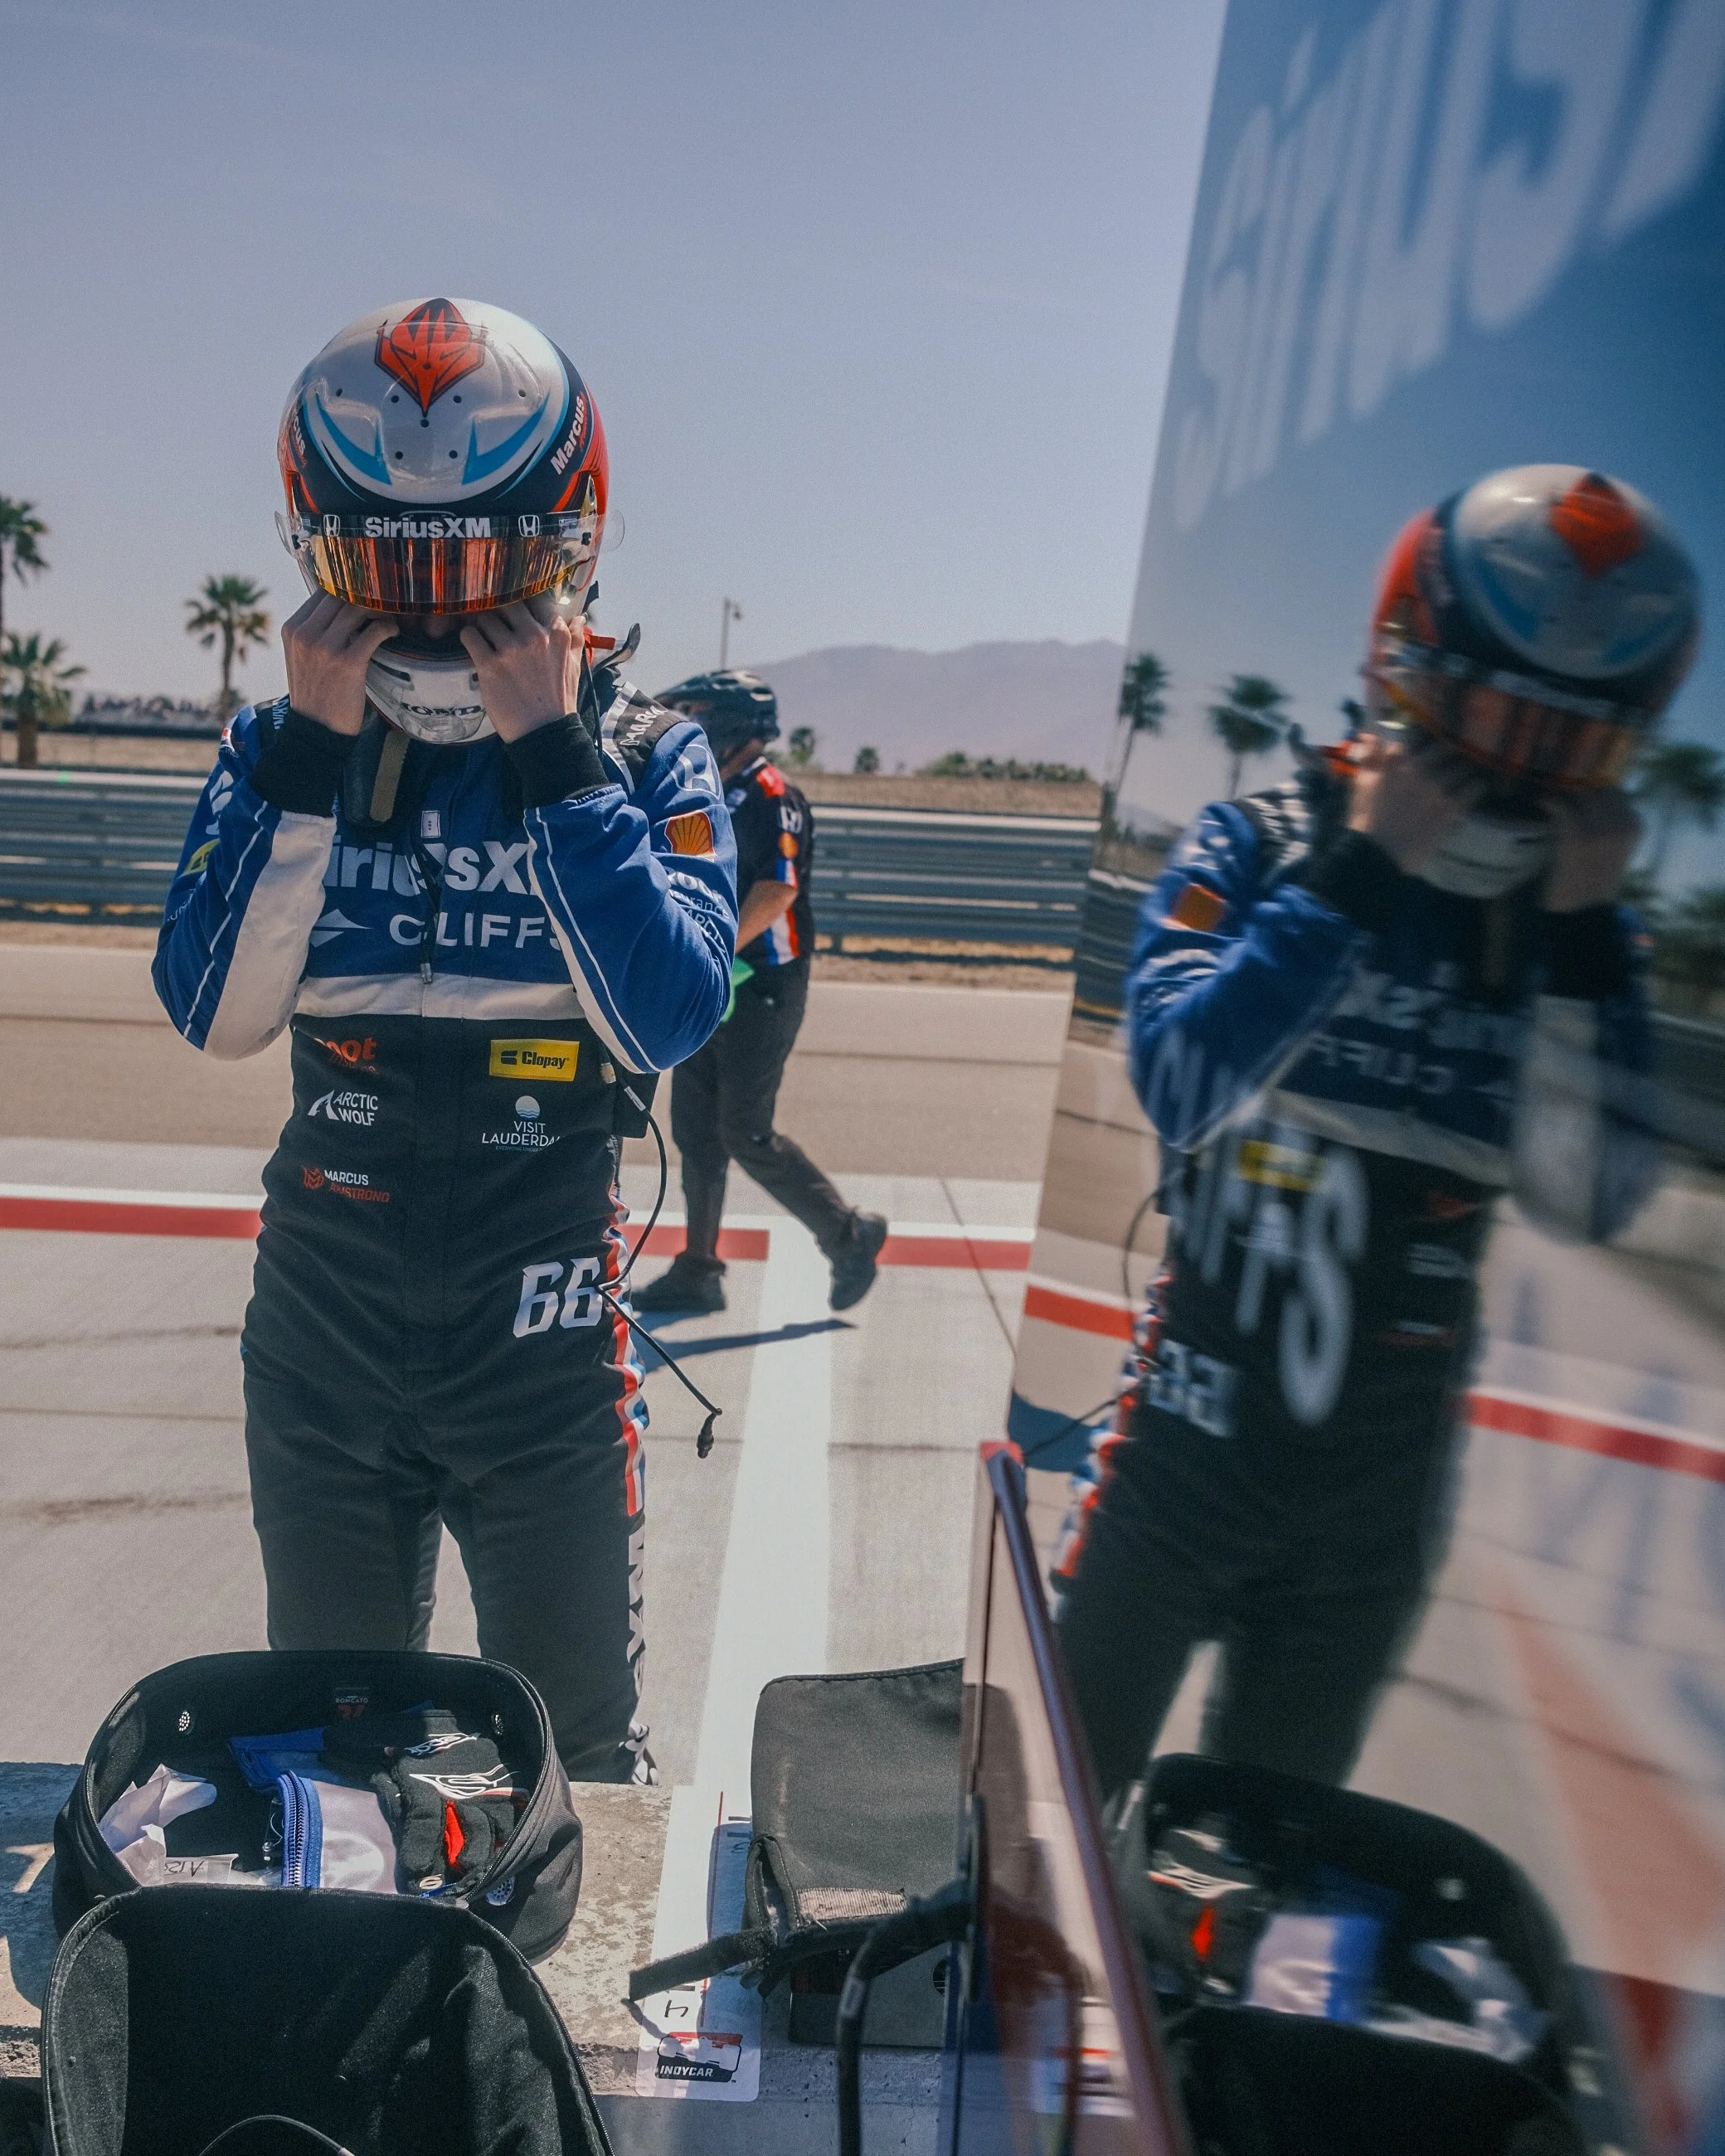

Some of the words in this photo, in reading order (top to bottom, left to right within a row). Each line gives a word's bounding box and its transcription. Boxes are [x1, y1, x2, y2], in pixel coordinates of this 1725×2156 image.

[551, 396, 584, 475] Marcus
[365, 516, 491, 538] SiriusXM
[522, 1051, 566, 1070] Clopay
[333, 1091, 379, 1111] ARCTIC
[338, 1107, 375, 1126] WOLF
[513, 1120, 547, 1134] VISIT
[323, 1169, 369, 1186] MARCUS
[513, 1256, 604, 1338] 66
[659, 2064, 713, 2078] INDYCAR
